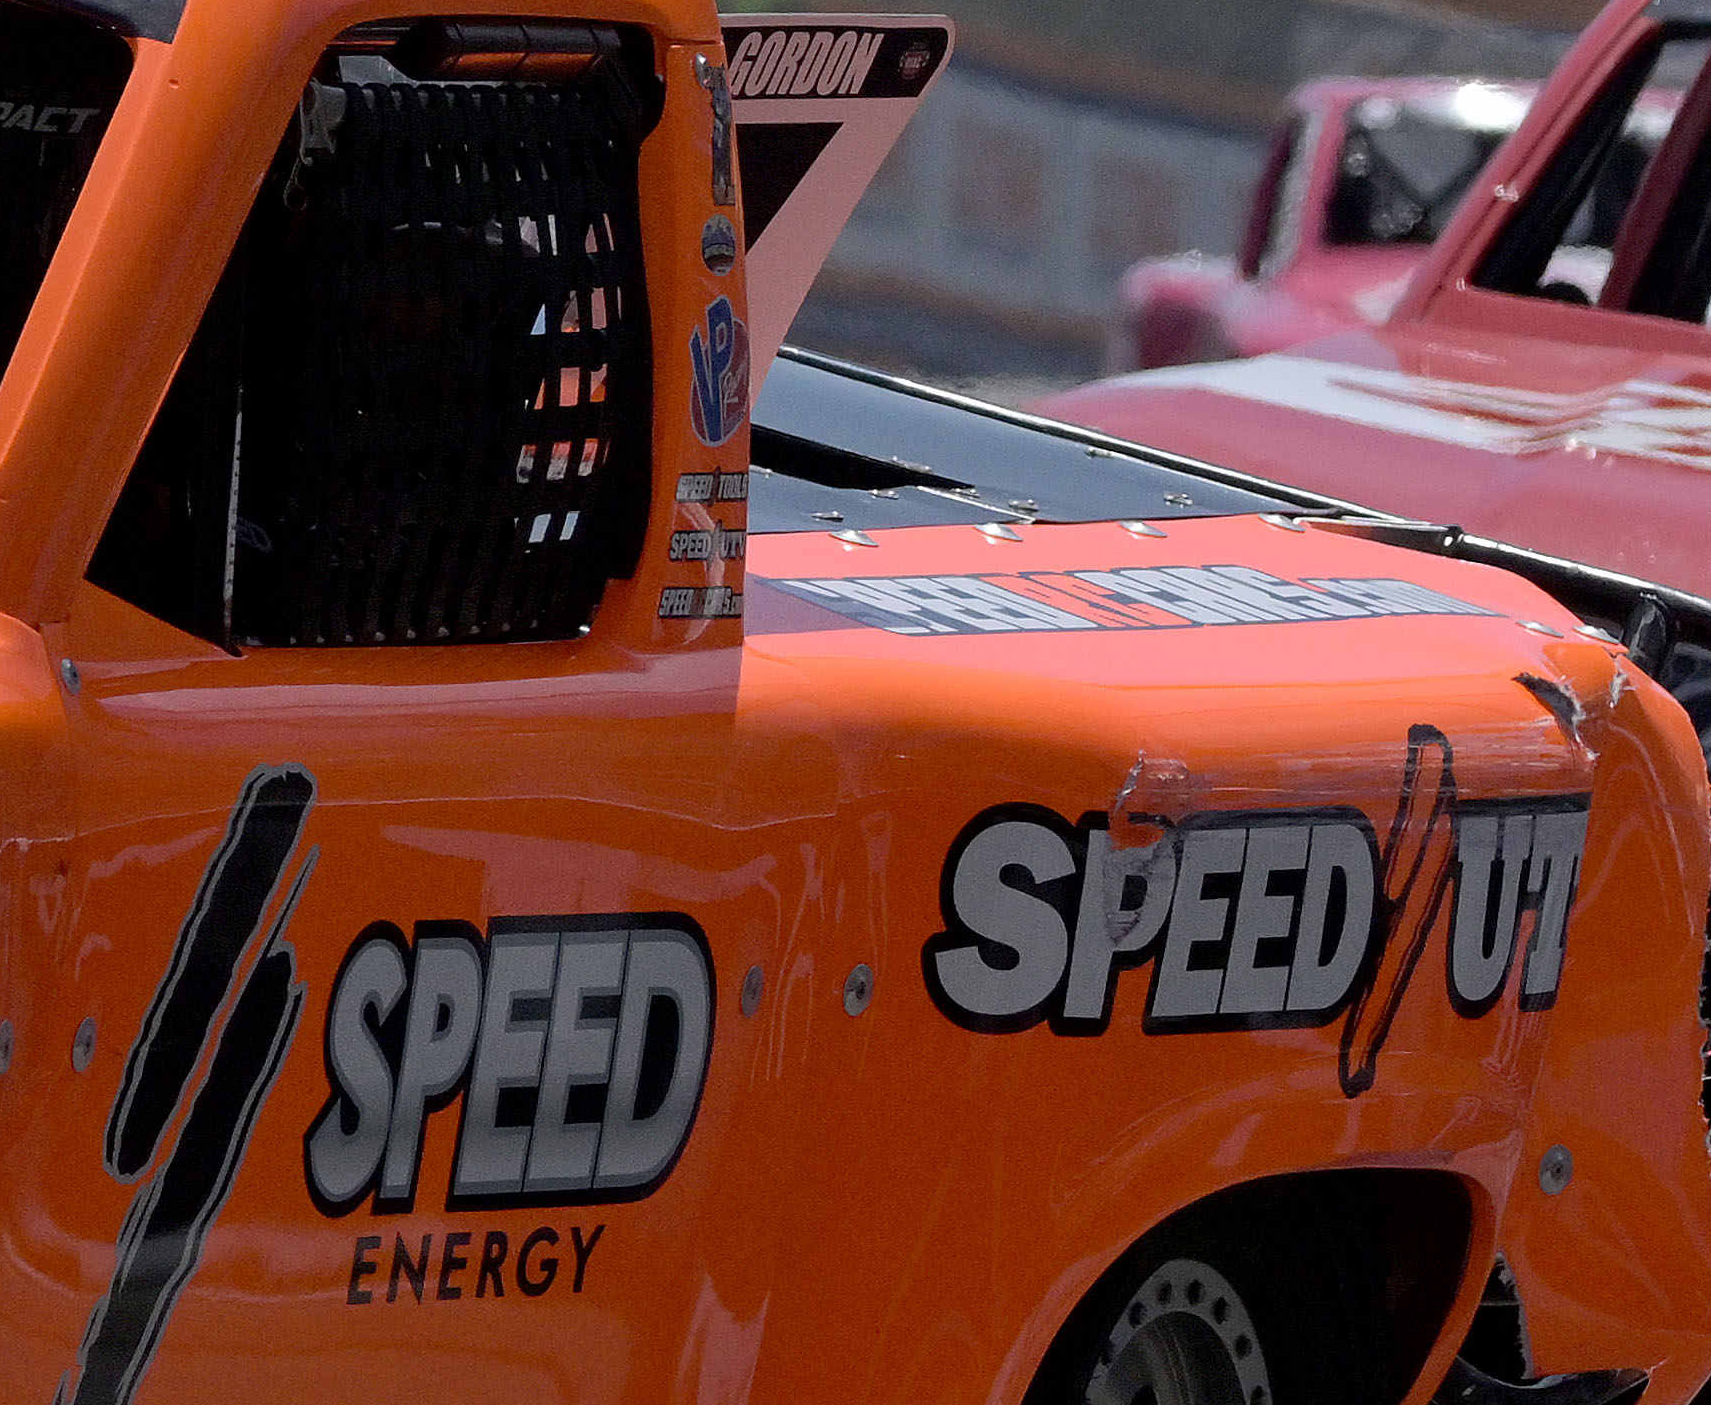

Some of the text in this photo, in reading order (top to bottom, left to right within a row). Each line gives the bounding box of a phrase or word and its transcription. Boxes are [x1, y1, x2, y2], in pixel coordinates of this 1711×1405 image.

[728, 30, 886, 97] GORDON
[669, 532, 713, 559] SPEED
[928, 811, 1380, 1024] SPEED
[306, 916, 716, 1211] SPEED
[346, 1225, 606, 1306] ENERGY
